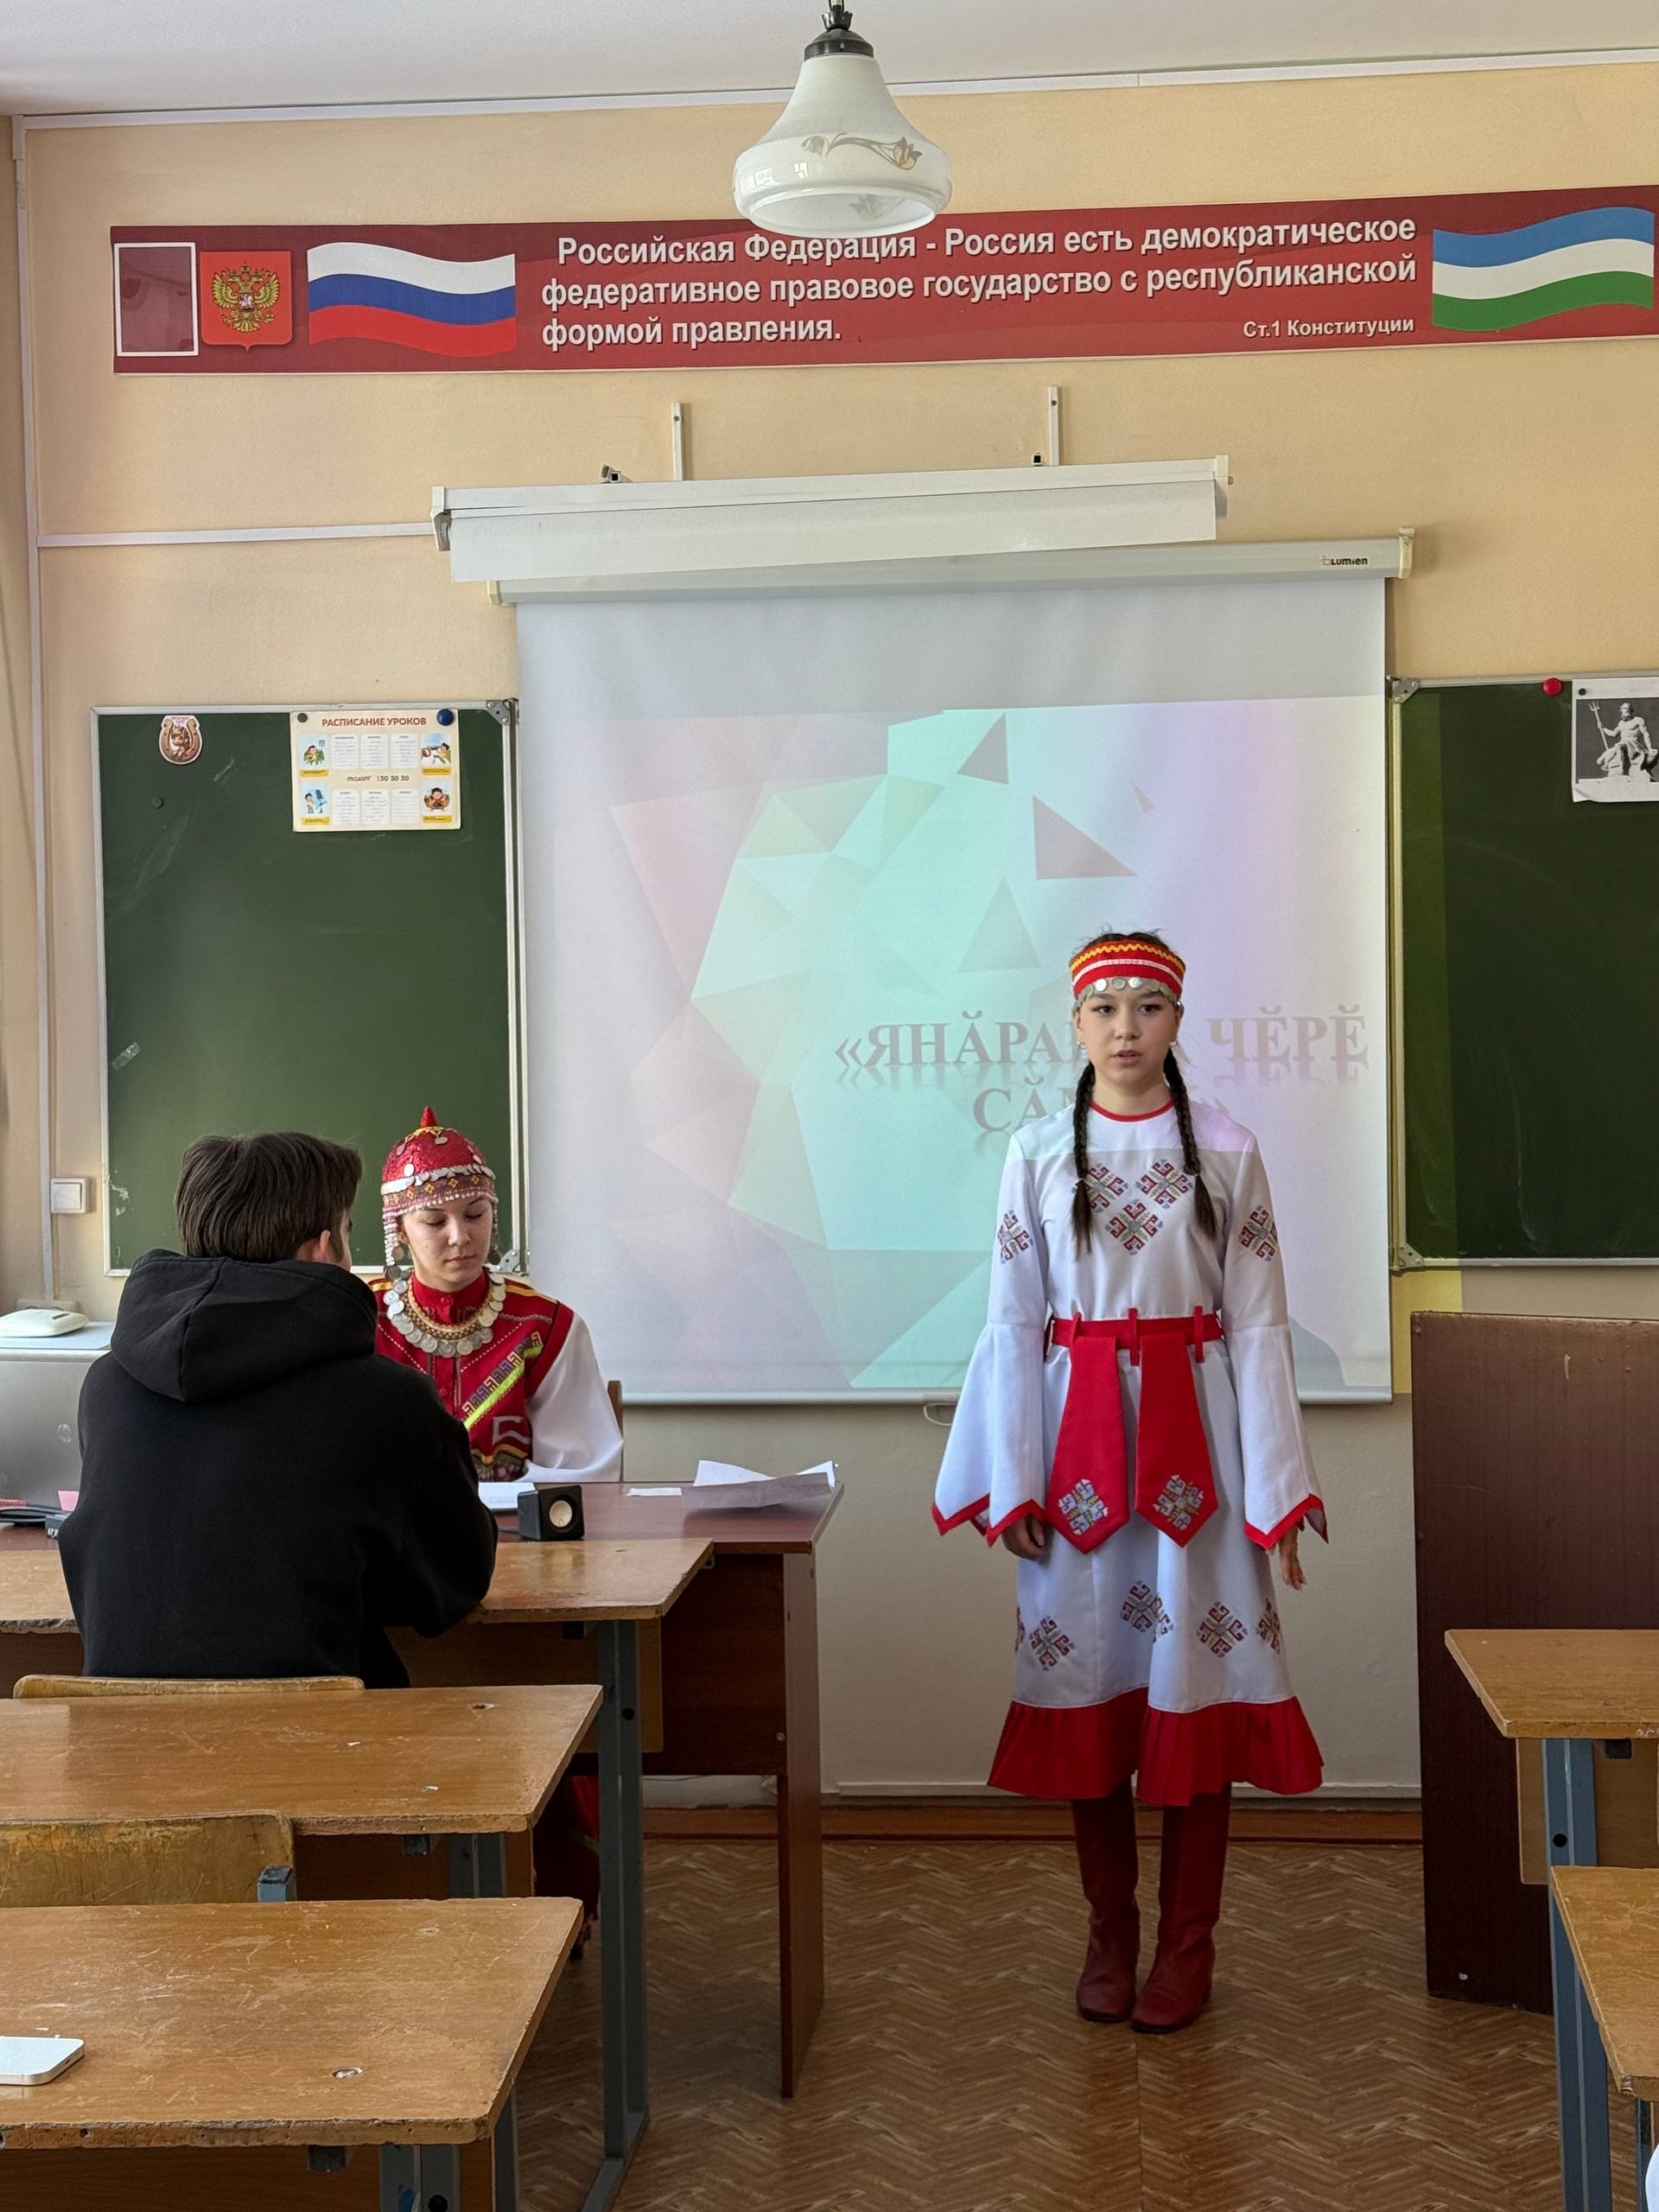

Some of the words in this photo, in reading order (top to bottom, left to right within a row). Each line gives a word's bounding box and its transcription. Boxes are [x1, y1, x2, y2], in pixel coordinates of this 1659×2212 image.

[557, 234, 734, 265] Российская
[744, 233, 916, 266] Федерация
[944, 227, 1055, 256] Россия
[1064, 229, 1133, 252] есть
[1140, 218, 1416, 255] демократическое
[541, 277, 761, 312] федеративное
[770, 276, 914, 308] правовое
[923, 270, 1112, 303] государство
[1120, 269, 1139, 291] с
[1147, 252, 1416, 298] республиканской
[541, 315, 663, 352] формой
[671, 319, 842, 350] правления.
[1243, 321, 1281, 338] Ст.1
[1287, 319, 1414, 338] Конституции
[321, 718, 385, 727] РАСПИСАНИЕ
[386, 717, 427, 726] УРОКОВ
